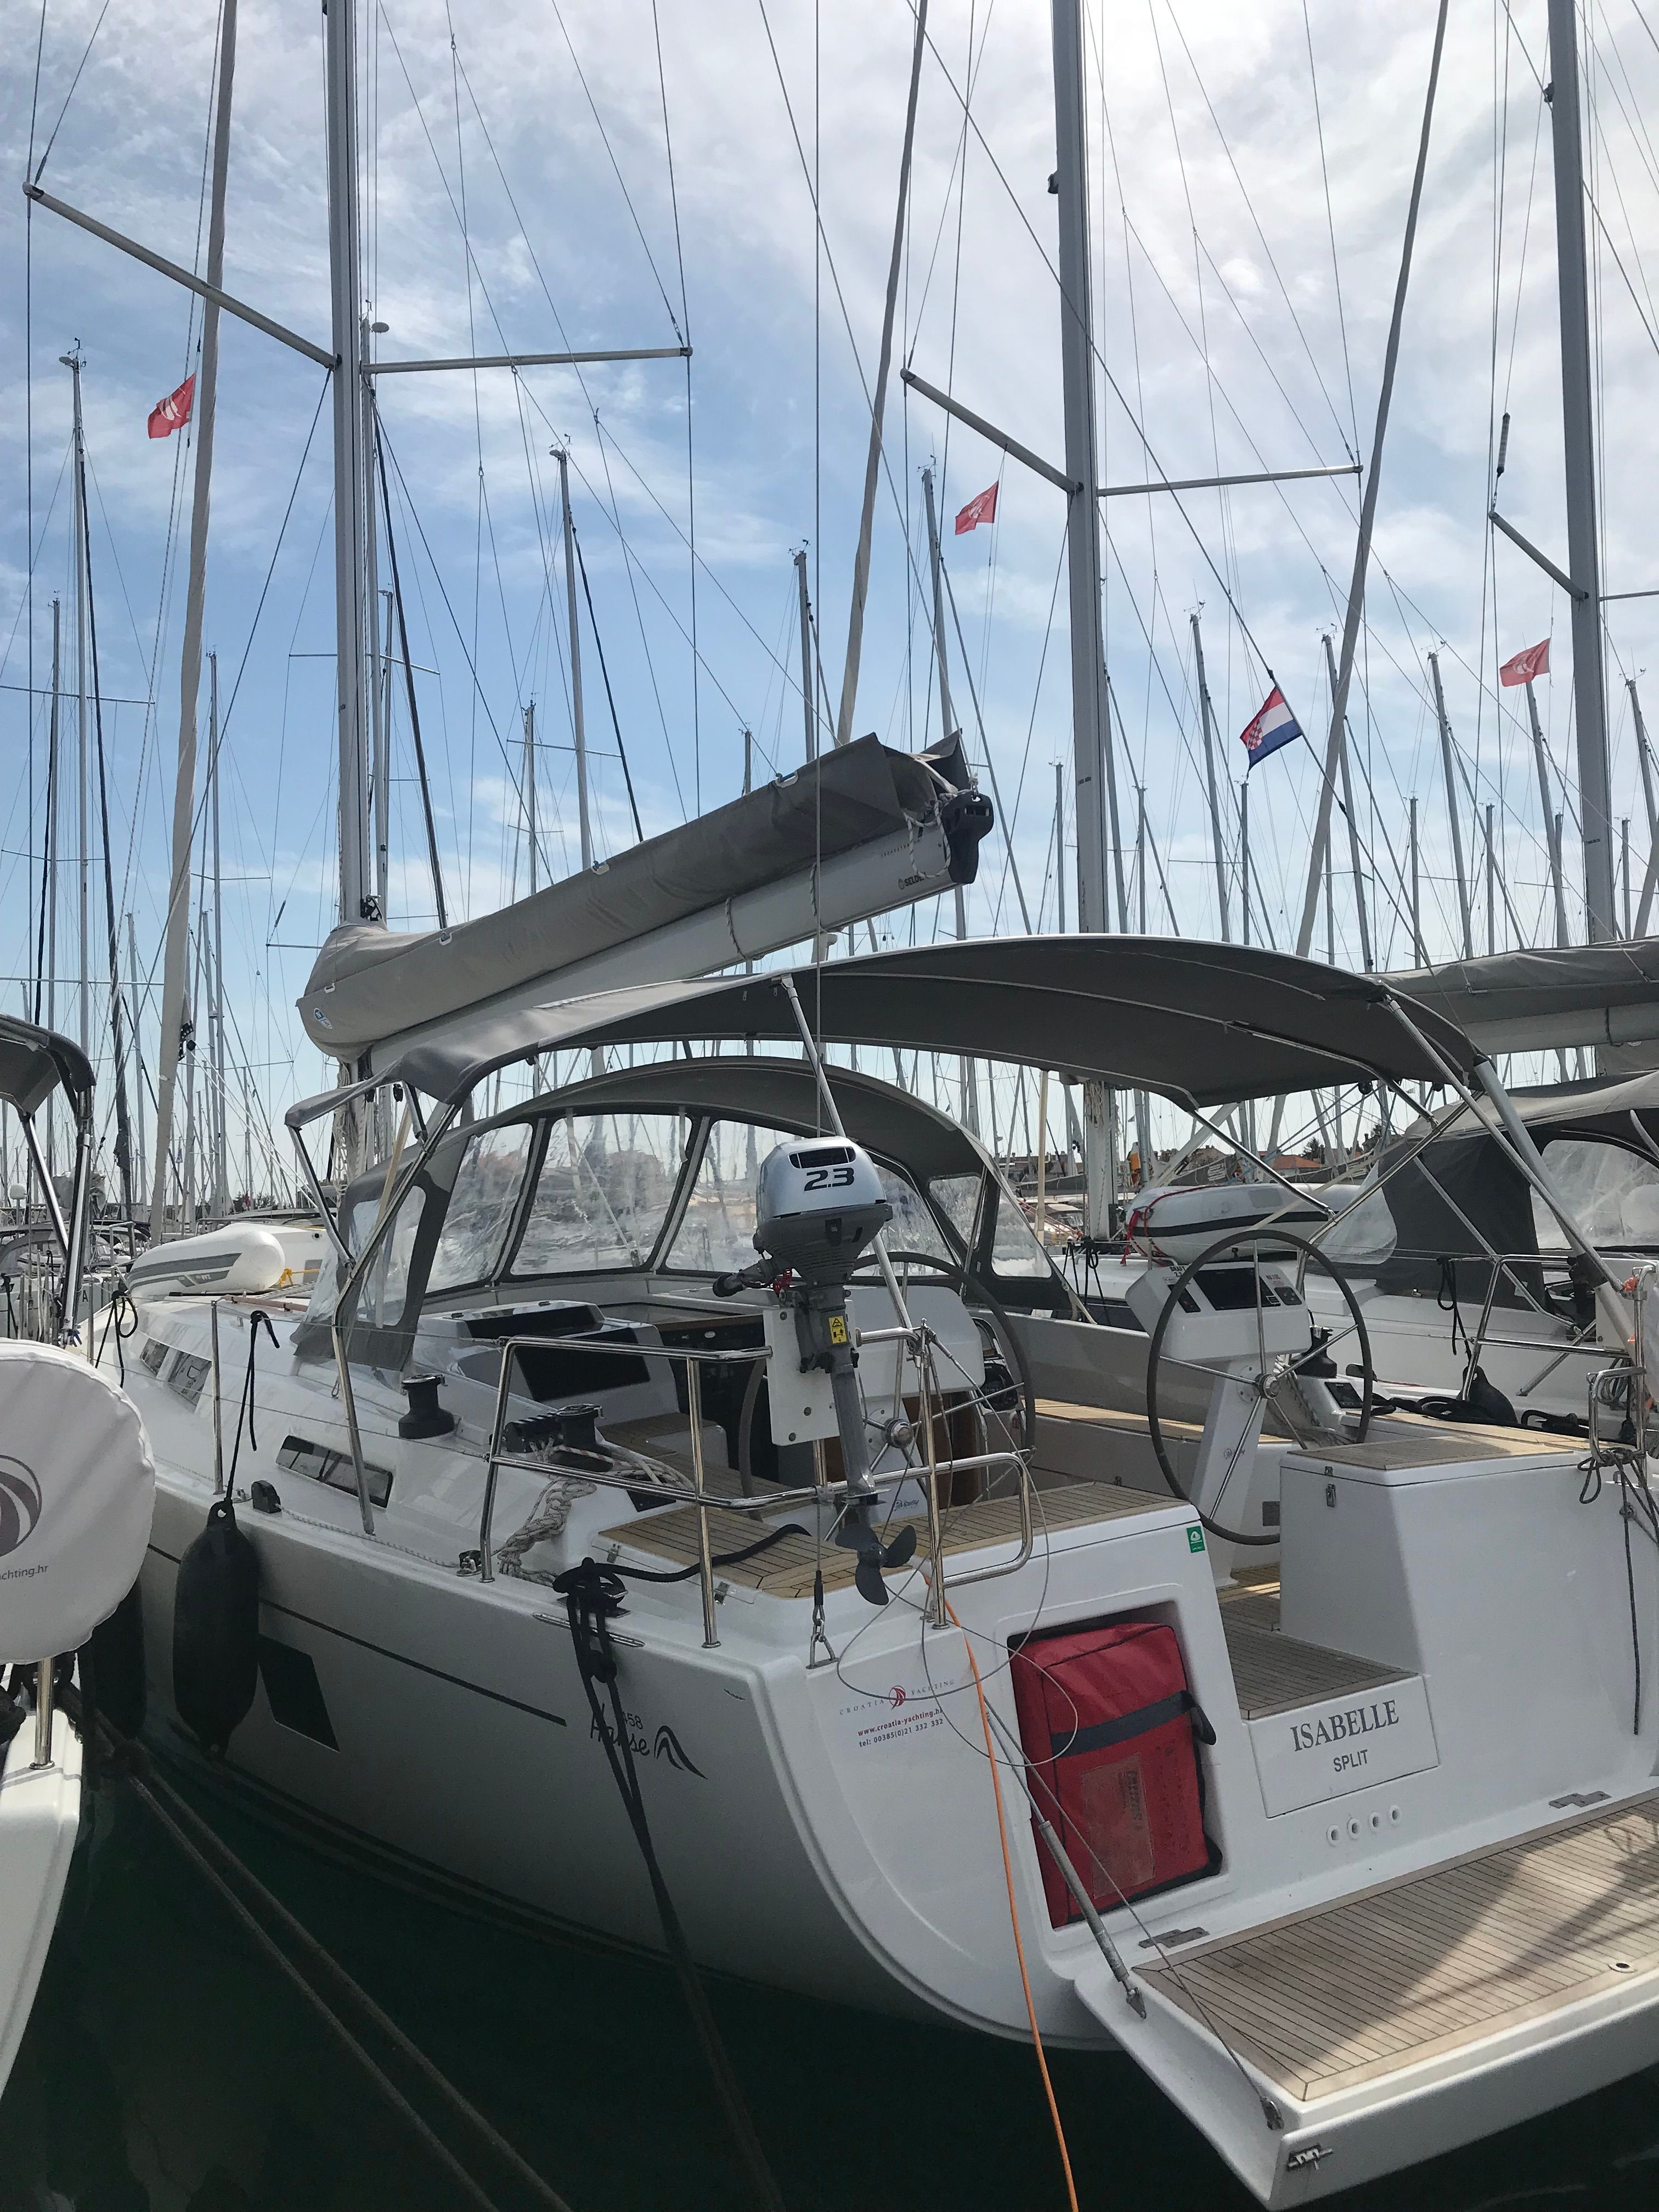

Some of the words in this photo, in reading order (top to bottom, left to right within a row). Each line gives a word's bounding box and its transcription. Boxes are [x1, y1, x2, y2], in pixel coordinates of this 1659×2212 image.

[904, 871, 929, 887] SELDE
[804, 1167, 854, 1191] 2.3
[0, 1564, 49, 1580] chting.hr
[839, 1699, 884, 1715] CROATIA
[859, 1739, 871, 1747] tel:
[873, 1726, 912, 1743] 00385(0)21
[916, 1723, 928, 1731] 332
[931, 1718, 944, 1726] 332
[1290, 1700, 1399, 1752] ISABELLE
[1333, 1749, 1368, 1772] SPLIT
